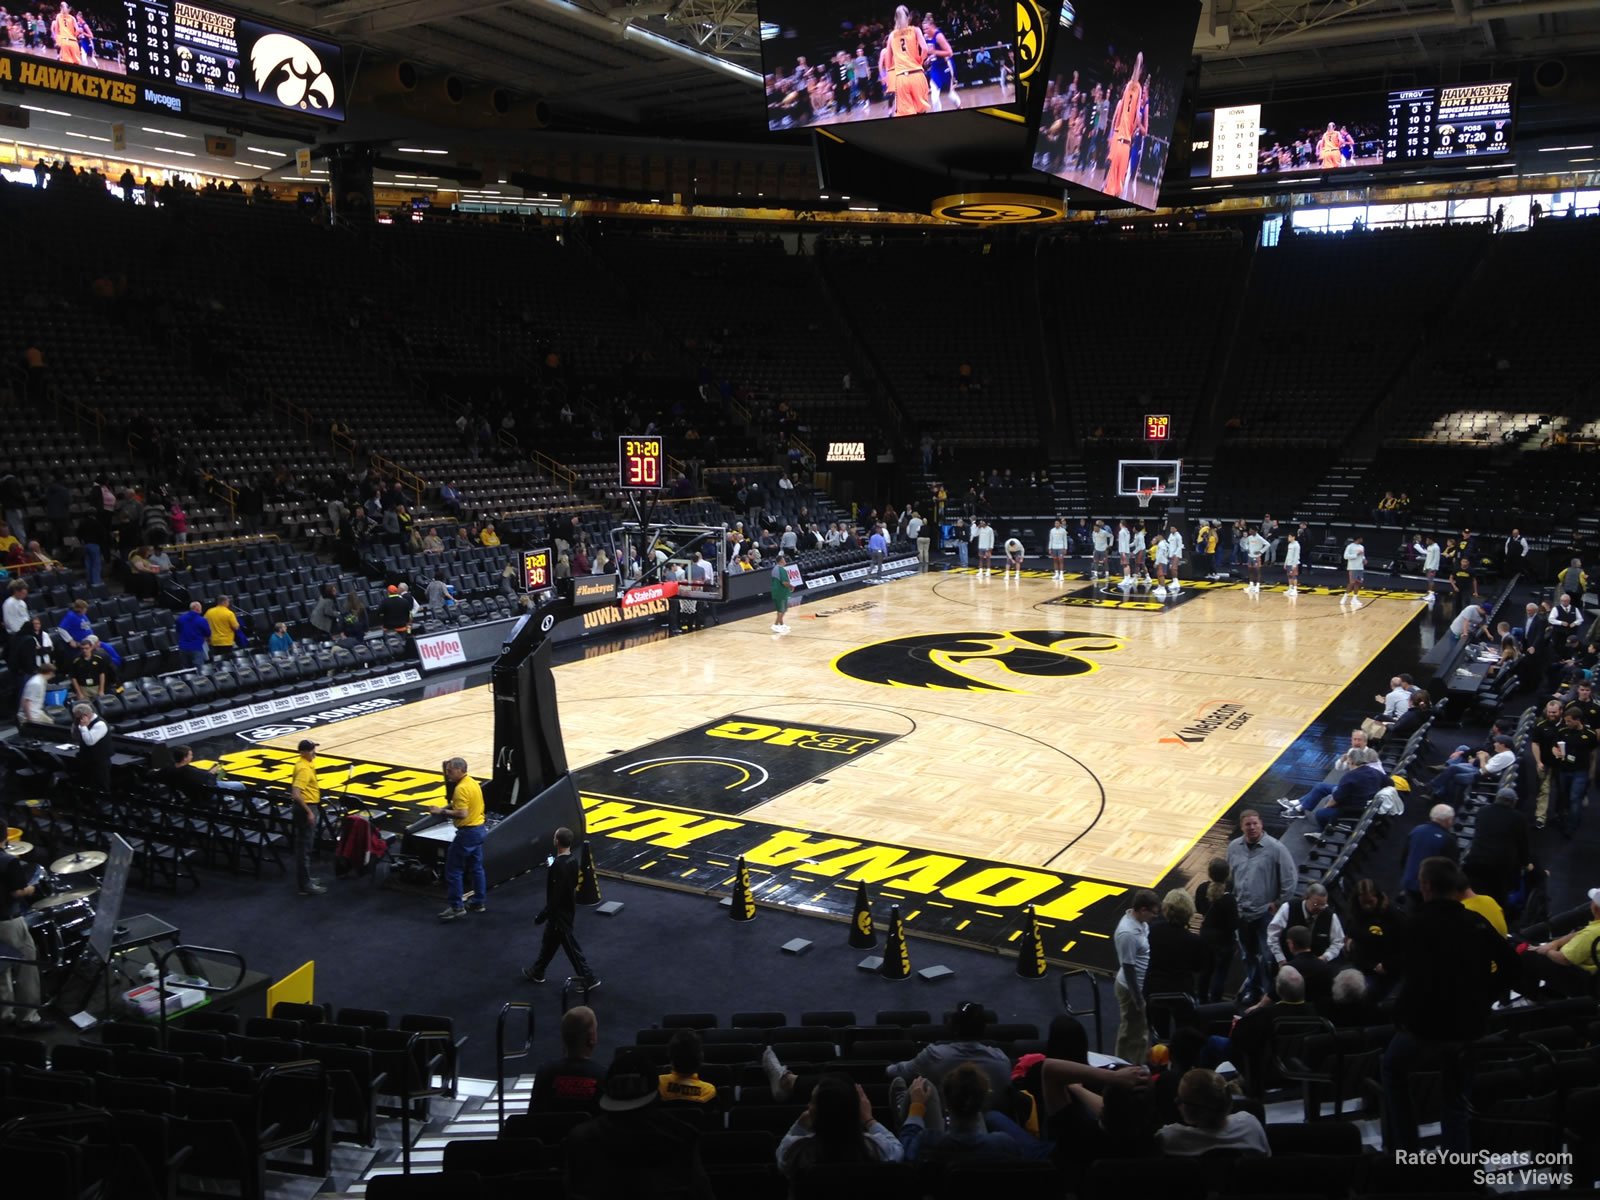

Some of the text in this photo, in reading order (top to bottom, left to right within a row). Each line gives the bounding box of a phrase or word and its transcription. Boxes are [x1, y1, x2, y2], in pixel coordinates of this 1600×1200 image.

[128, 8, 167, 25] 1 0 3
[174, 2, 236, 30] HAWKEYES
[127, 20, 136, 29] 11
[147, 25, 157, 35] 10
[162, 28, 168, 37] 0
[175, 16, 200, 28] HOME
[202, 22, 235, 38] EVENTS
[128, 33, 169, 50] 12 22 3
[128, 47, 170, 64] 21 15 3
[200, 54, 216, 65] POSS
[129, 61, 171, 78] 45 11 3
[181, 60, 235, 83] 0 37:20 0
[19, 62, 137, 105] HAWKEYES
[1441, 83, 1511, 100] HAWKEYES
[145, 89, 181, 108] Mycogen
[1400, 91, 1423, 99] UTRGV
[1440, 95, 1508, 107] HOME EVENTS
[1392, 108, 1396, 116] 1
[1412, 106, 1418, 114] 0
[1424, 115, 1431, 123] 0
[1388, 128, 1398, 136] 12
[1424, 125, 1430, 133] 3
[1442, 131, 1503, 146] 0 37:20 0
[1387, 140, 1396, 148] 21
[1407, 149, 1416, 157] 11
[1148, 417, 1168, 425] 37:20
[1150, 425, 1165, 438] 30
[627, 441, 659, 456] 37:20
[828, 442, 865, 455] IOWA
[826, 454, 866, 462] BASKETBALL
[630, 457, 656, 482] 30
[525, 554, 546, 570] 37:20
[529, 568, 544, 585] 30
[576, 583, 614, 596] #Hawkeyes
[583, 605, 622, 629] IOWA
[212, 713, 227, 722] zero
[293, 697, 400, 723] PIONEER
[167, 724, 183, 733] zero
[190, 719, 205, 728] zero
[1180, 704, 1246, 736] Mediacom
[1225, 712, 1255, 730] COURT
[736, 830, 1129, 921] IOWA
[741, 867, 756, 919] IOWA
[897, 919, 910, 976] IOWA
[1034, 918, 1047, 976] IOWA
